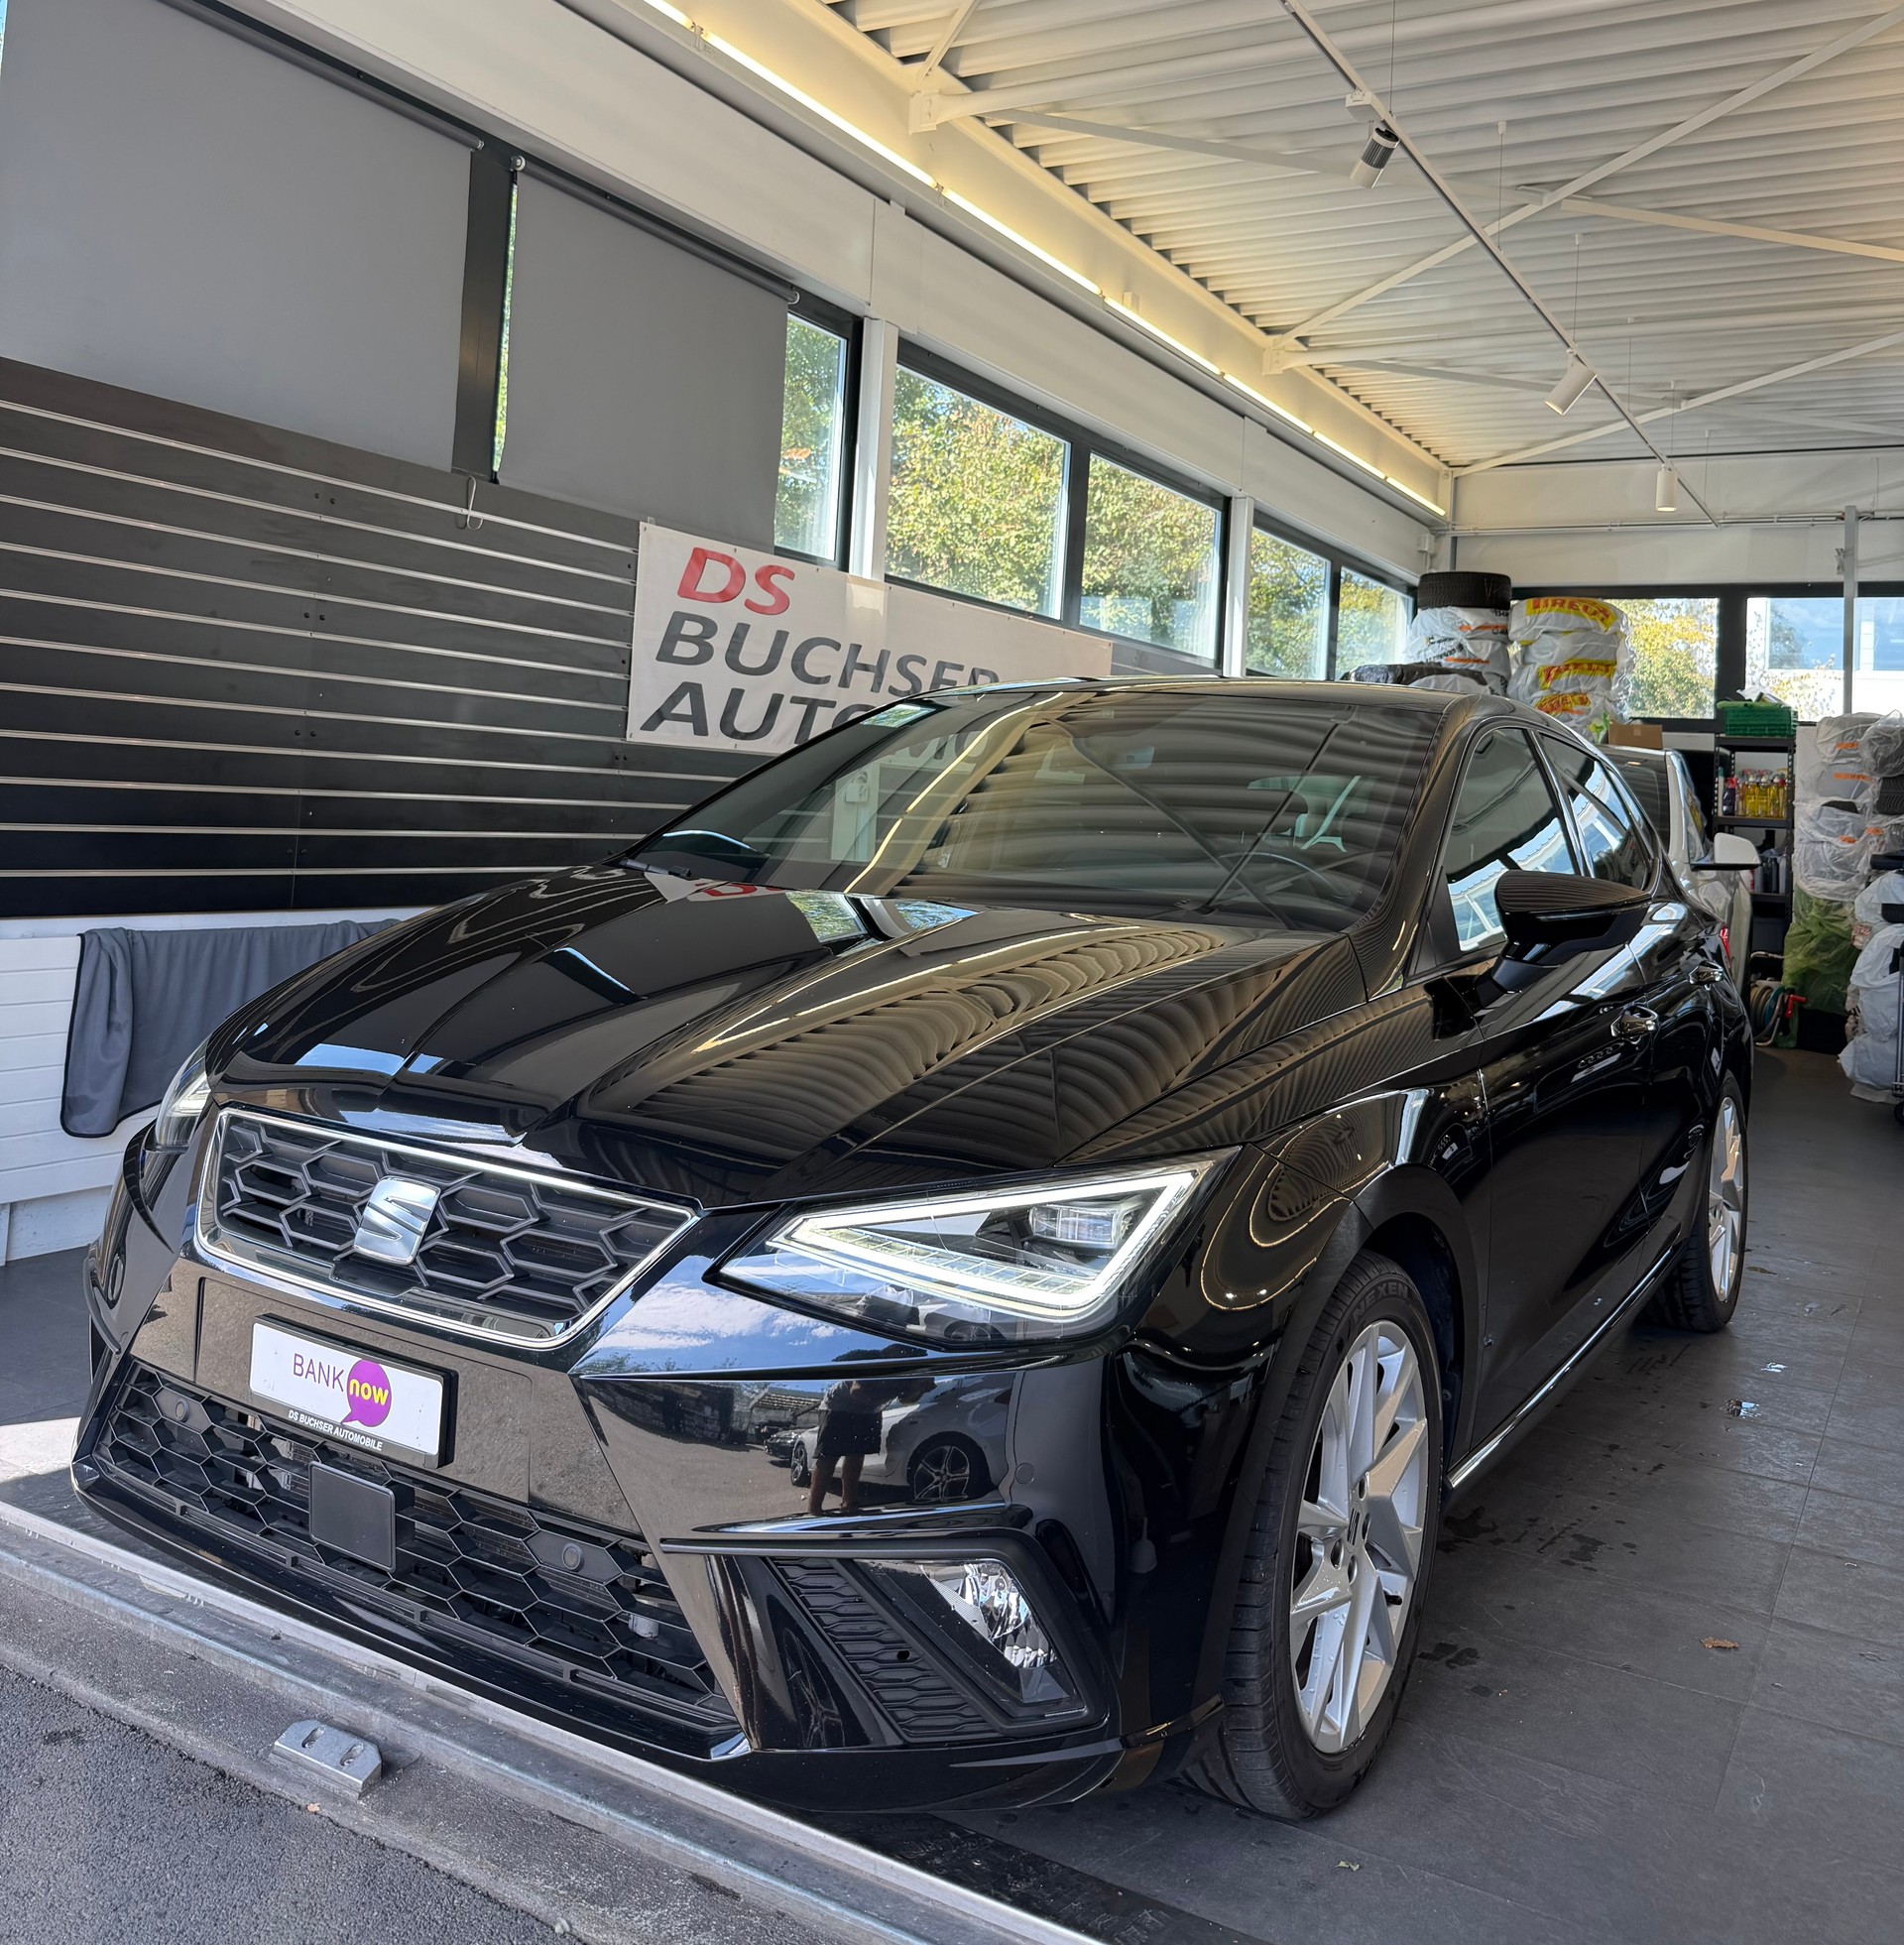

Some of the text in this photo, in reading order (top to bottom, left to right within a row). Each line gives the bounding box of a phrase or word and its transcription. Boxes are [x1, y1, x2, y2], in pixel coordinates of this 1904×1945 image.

[676, 547, 795, 616] DS
[1352, 1281, 1408, 1323] NEXEN
[294, 1353, 344, 1393] BANK
[349, 1378, 389, 1405] now
[289, 1409, 383, 1451] DS BUCHSER AUTOMOBILE
